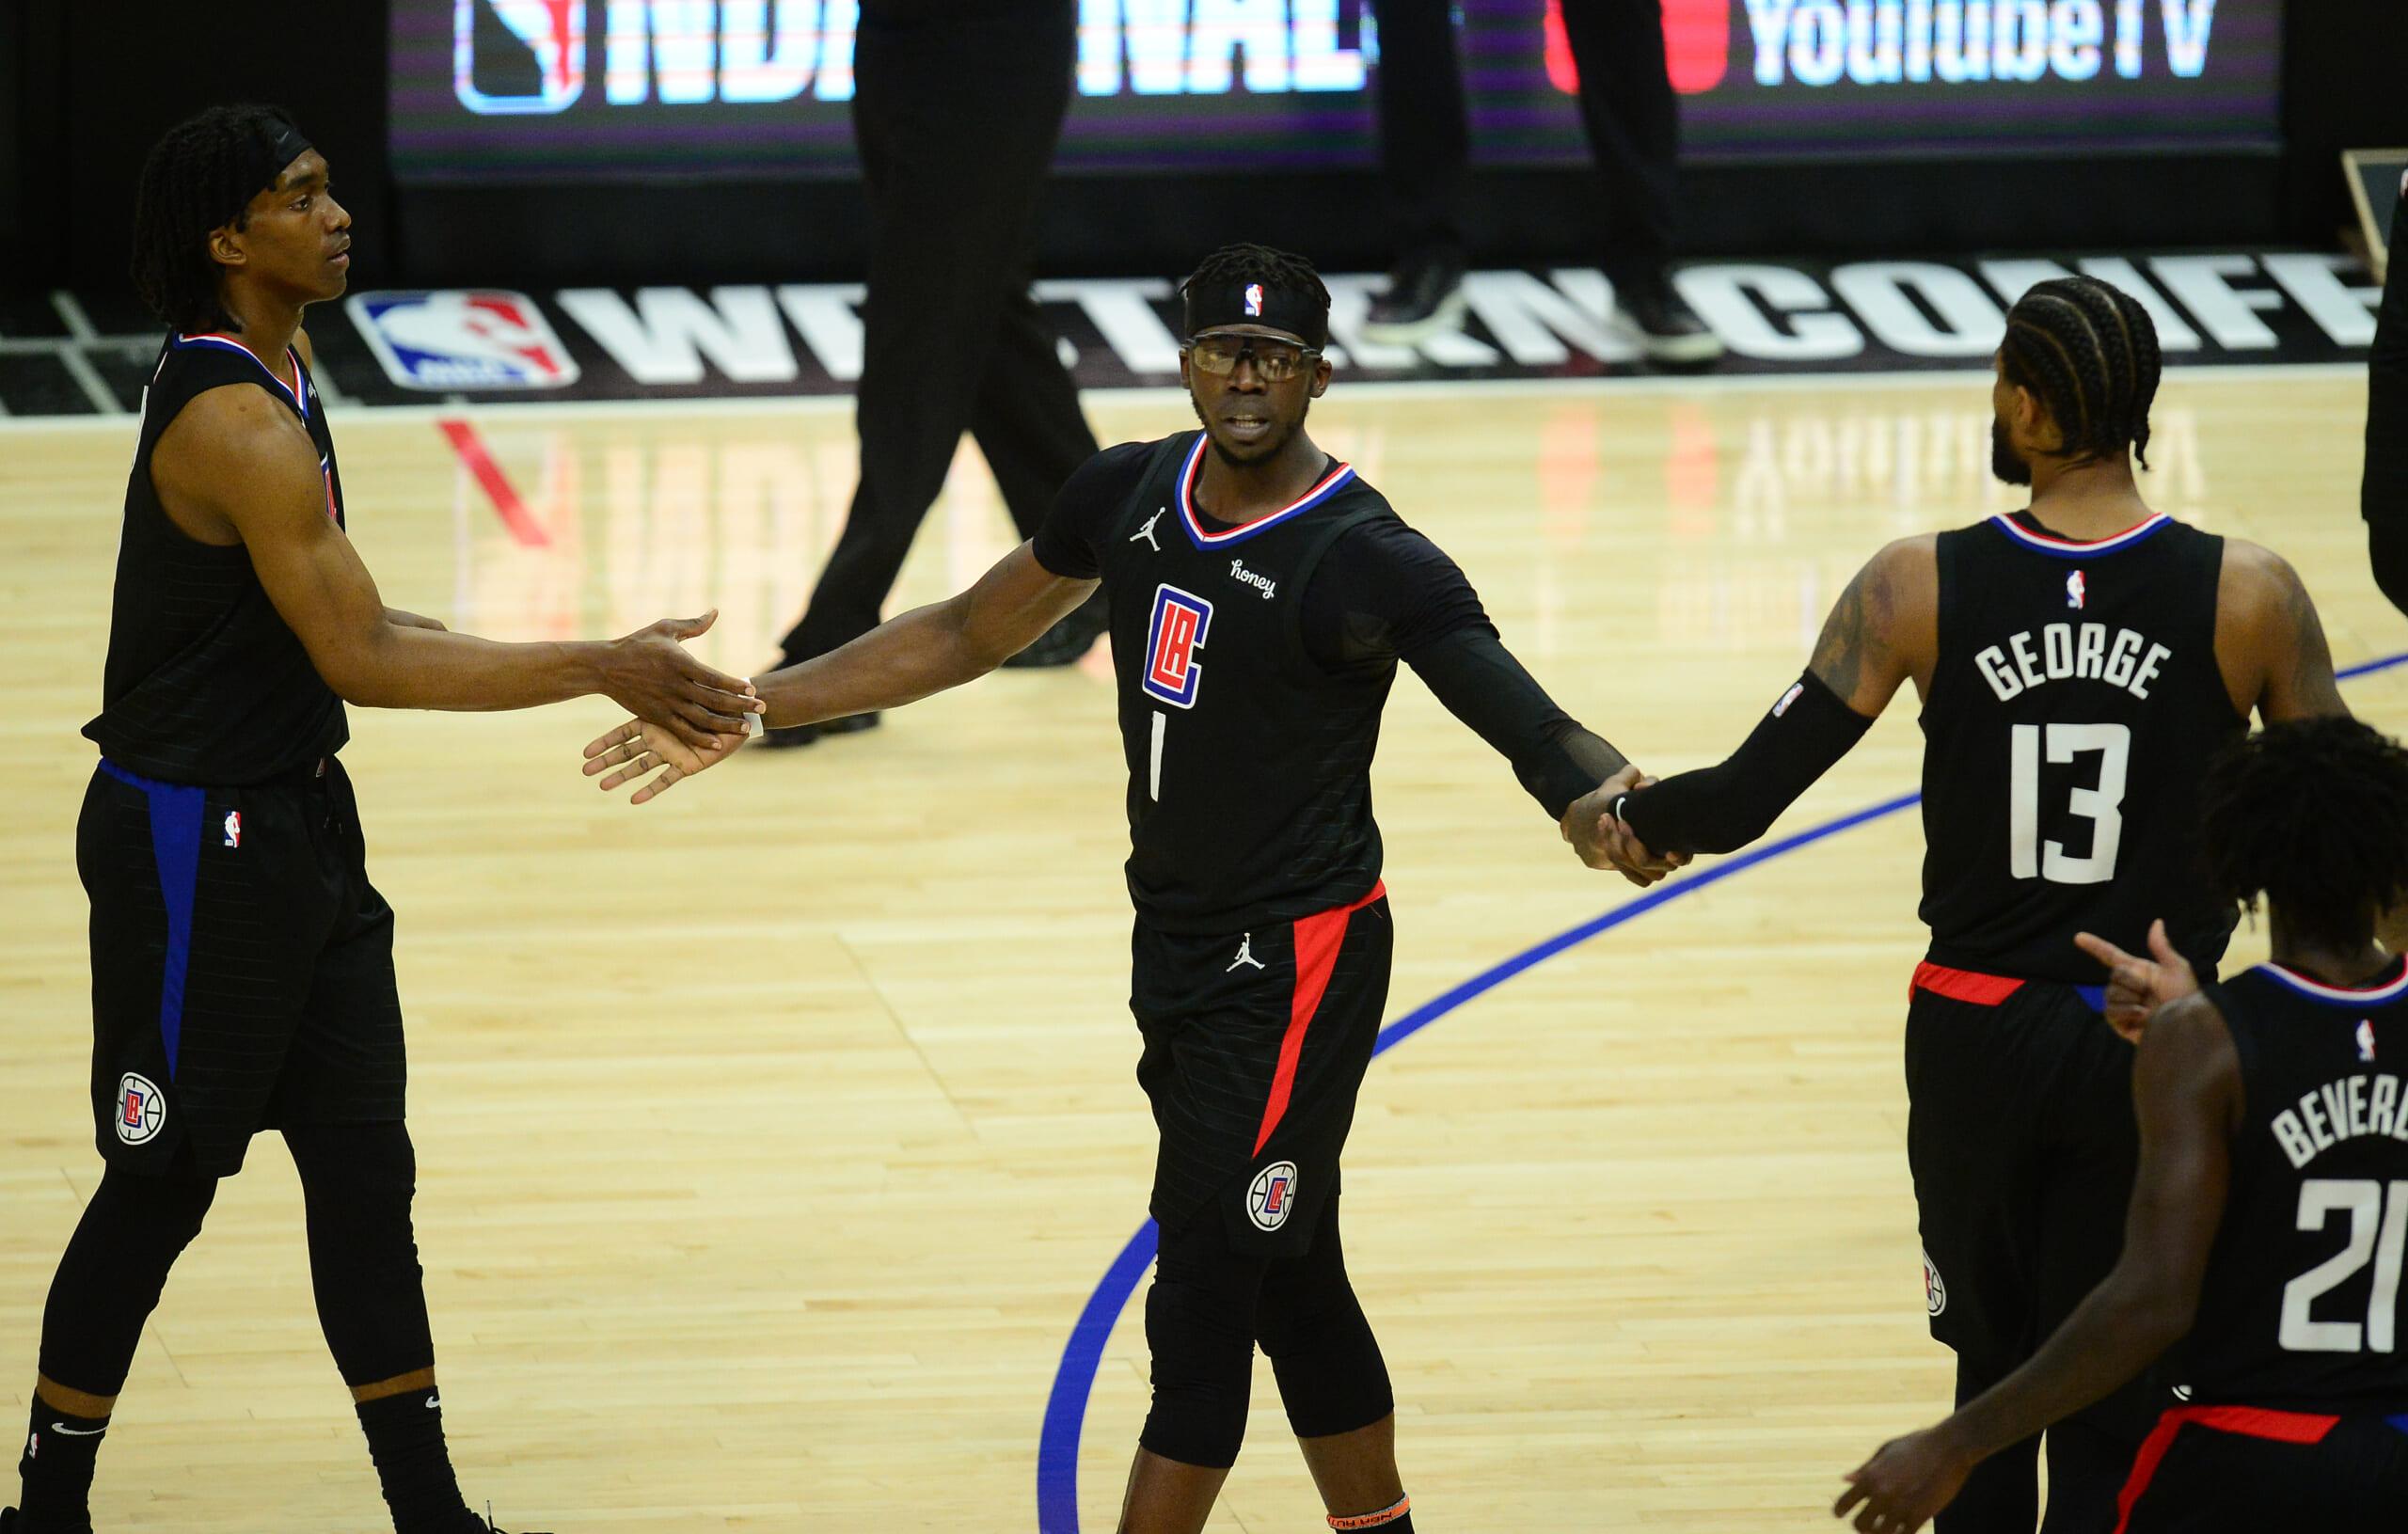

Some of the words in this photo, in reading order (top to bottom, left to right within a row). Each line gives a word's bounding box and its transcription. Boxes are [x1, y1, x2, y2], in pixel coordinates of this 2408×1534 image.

[1229, 559, 1276, 599] honey
[1975, 623, 2172, 702] GEORGE
[1150, 711, 1166, 802] 1
[2010, 722, 2131, 884] 13
[2278, 1178, 2408, 1353] 21
